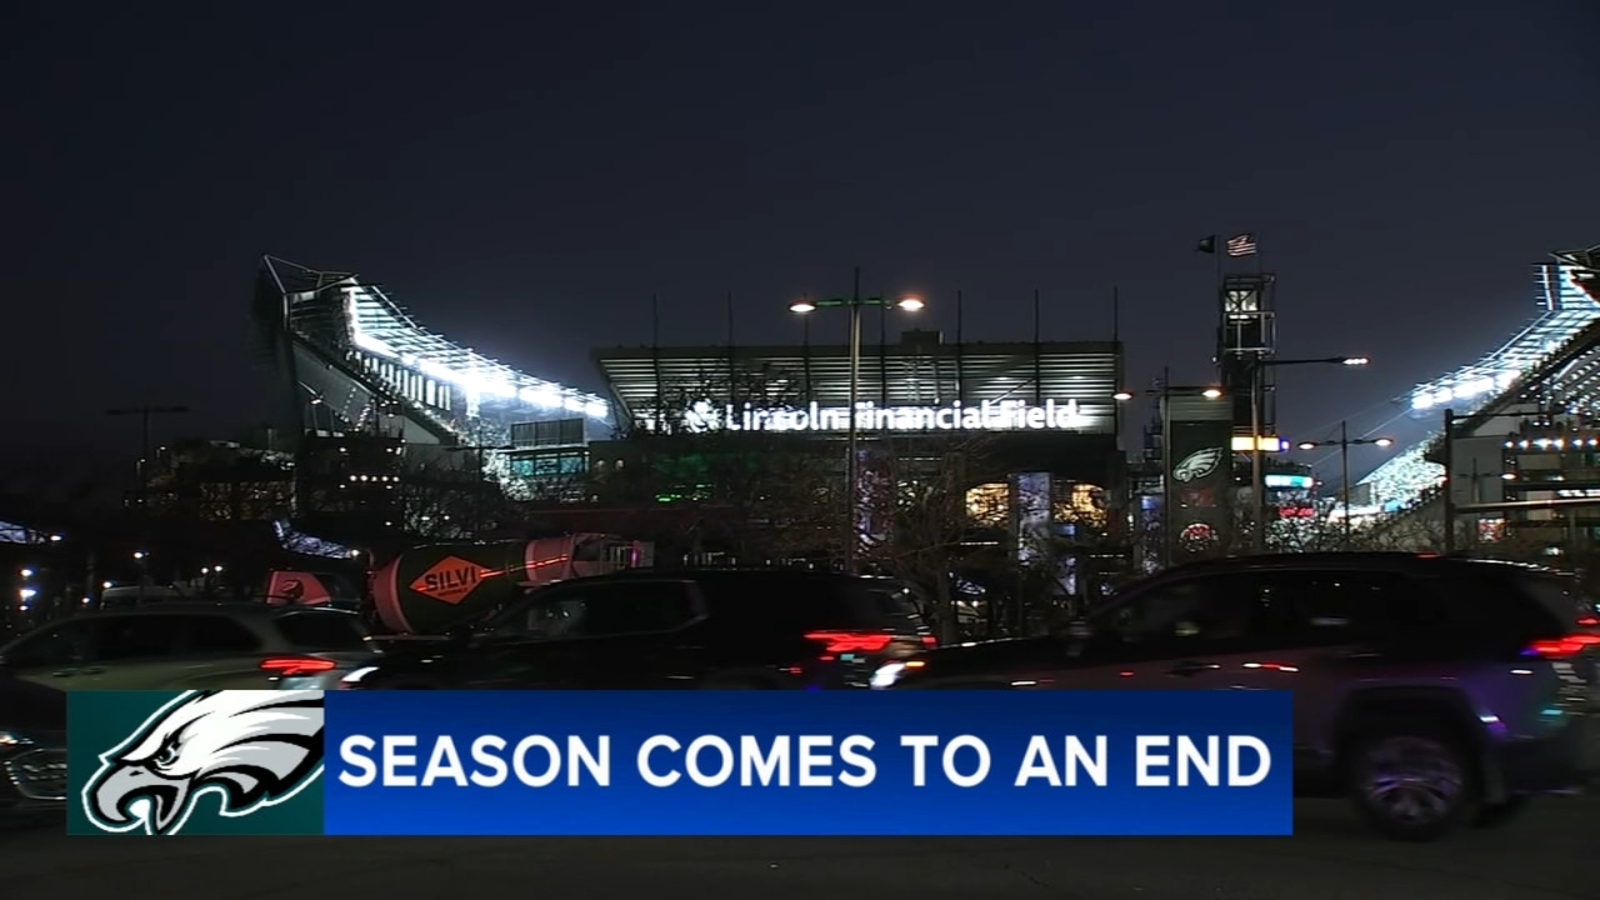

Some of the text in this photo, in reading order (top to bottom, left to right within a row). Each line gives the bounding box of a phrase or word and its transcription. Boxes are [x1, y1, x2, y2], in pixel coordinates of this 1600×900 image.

[725, 398, 1079, 431] Lincoln Financial Field
[424, 566, 477, 592] SILVI
